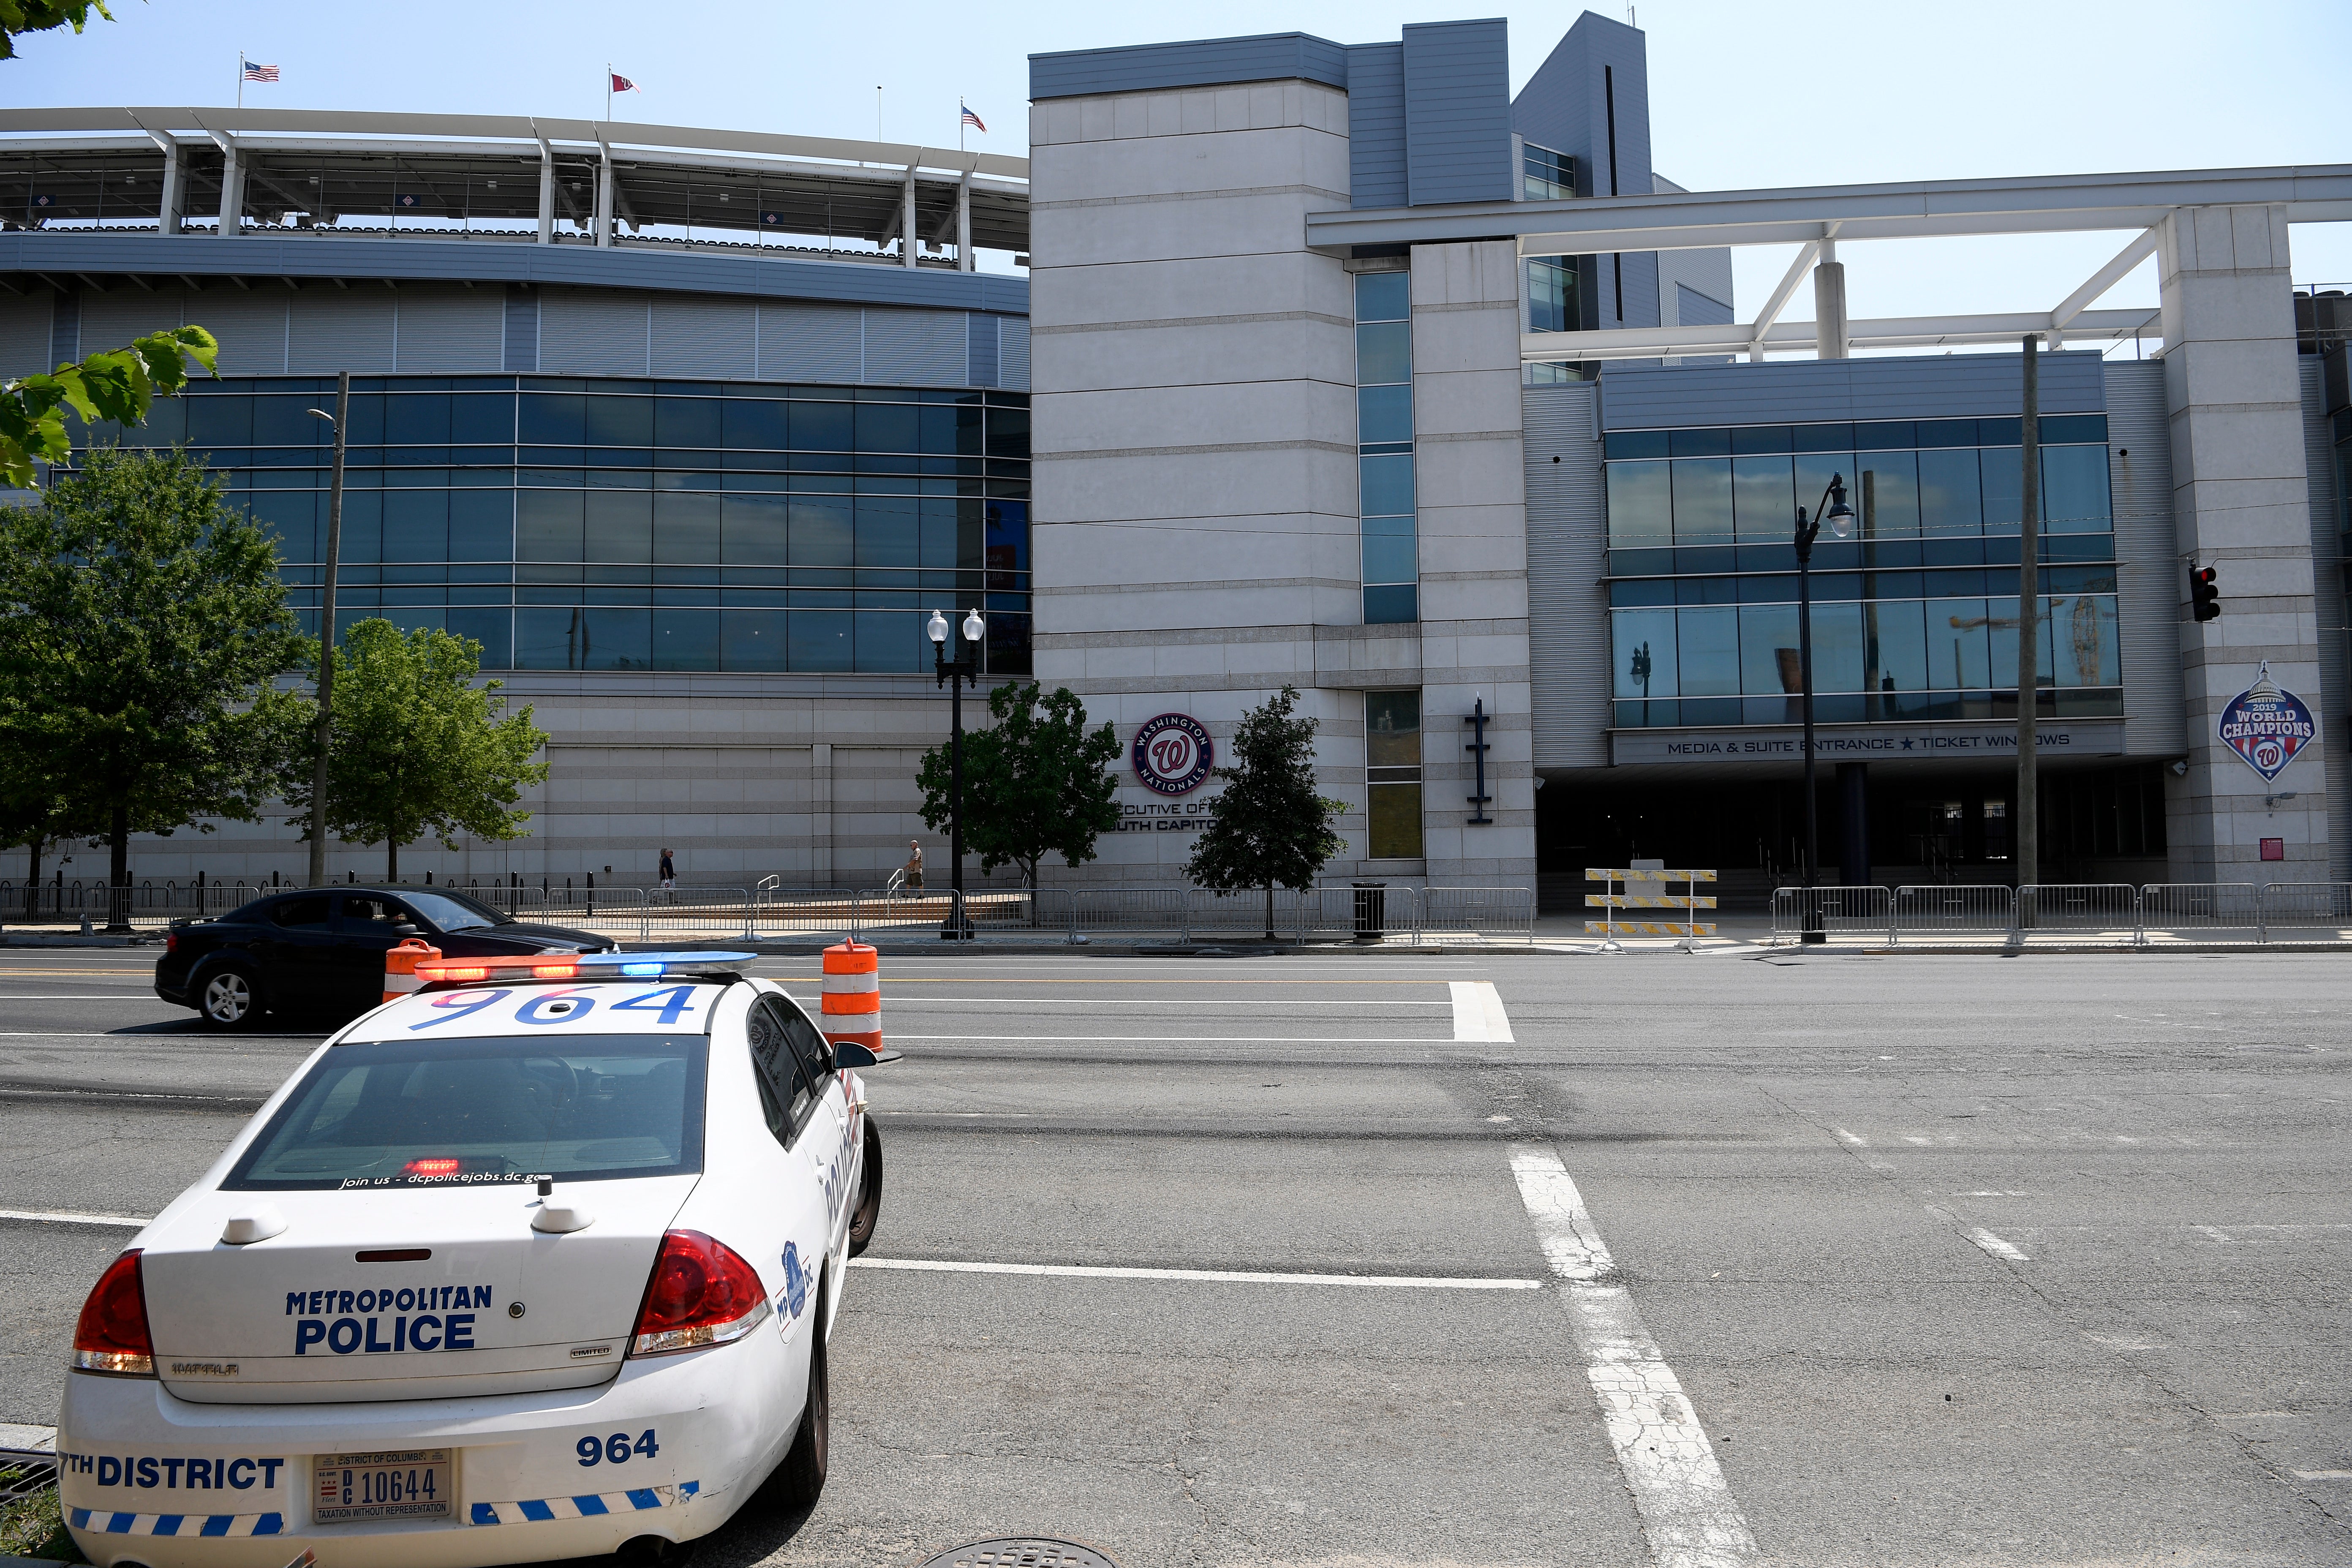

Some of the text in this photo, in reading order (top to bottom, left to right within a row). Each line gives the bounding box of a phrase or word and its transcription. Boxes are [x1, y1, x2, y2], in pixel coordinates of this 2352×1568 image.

[2236, 710, 2296, 722] WORLD
[1137, 717, 1208, 746] WASHINGTON
[2223, 722, 2311, 738] CHAMPIONS
[1669, 743, 1721, 754] MEDIA
[1727, 743, 1739, 753] &
[1745, 741, 1794, 752] SUITE
[1919, 737, 1981, 748] TICKET
[1985, 735, 2070, 746] WINOWS
[1141, 767, 1205, 791] NATIONALS
[1117, 804, 1181, 814] CUTIVE
[1157, 819, 1218, 830] CAPITO
[407, 985, 698, 1031] 964
[338, 1178, 368, 1190] Join
[374, 1176, 389, 1185] us
[408, 1171, 552, 1184] dcpolicejobs.dc.go
[286, 1285, 492, 1315] METROPOLITAN
[777, 1263, 813, 1325] MP DC
[295, 1314, 475, 1355] POLICE
[573, 1348, 609, 1356] LIMITED
[172, 1363, 238, 1375] IMPALA
[577, 1429, 659, 1467] 964
[374, 1454, 384, 1463] OF
[98, 1456, 284, 1489] DISTRICT
[362, 1469, 436, 1503] 10644
[318, 1503, 446, 1519] TAXATION WITHOUT REPRESENTATION
